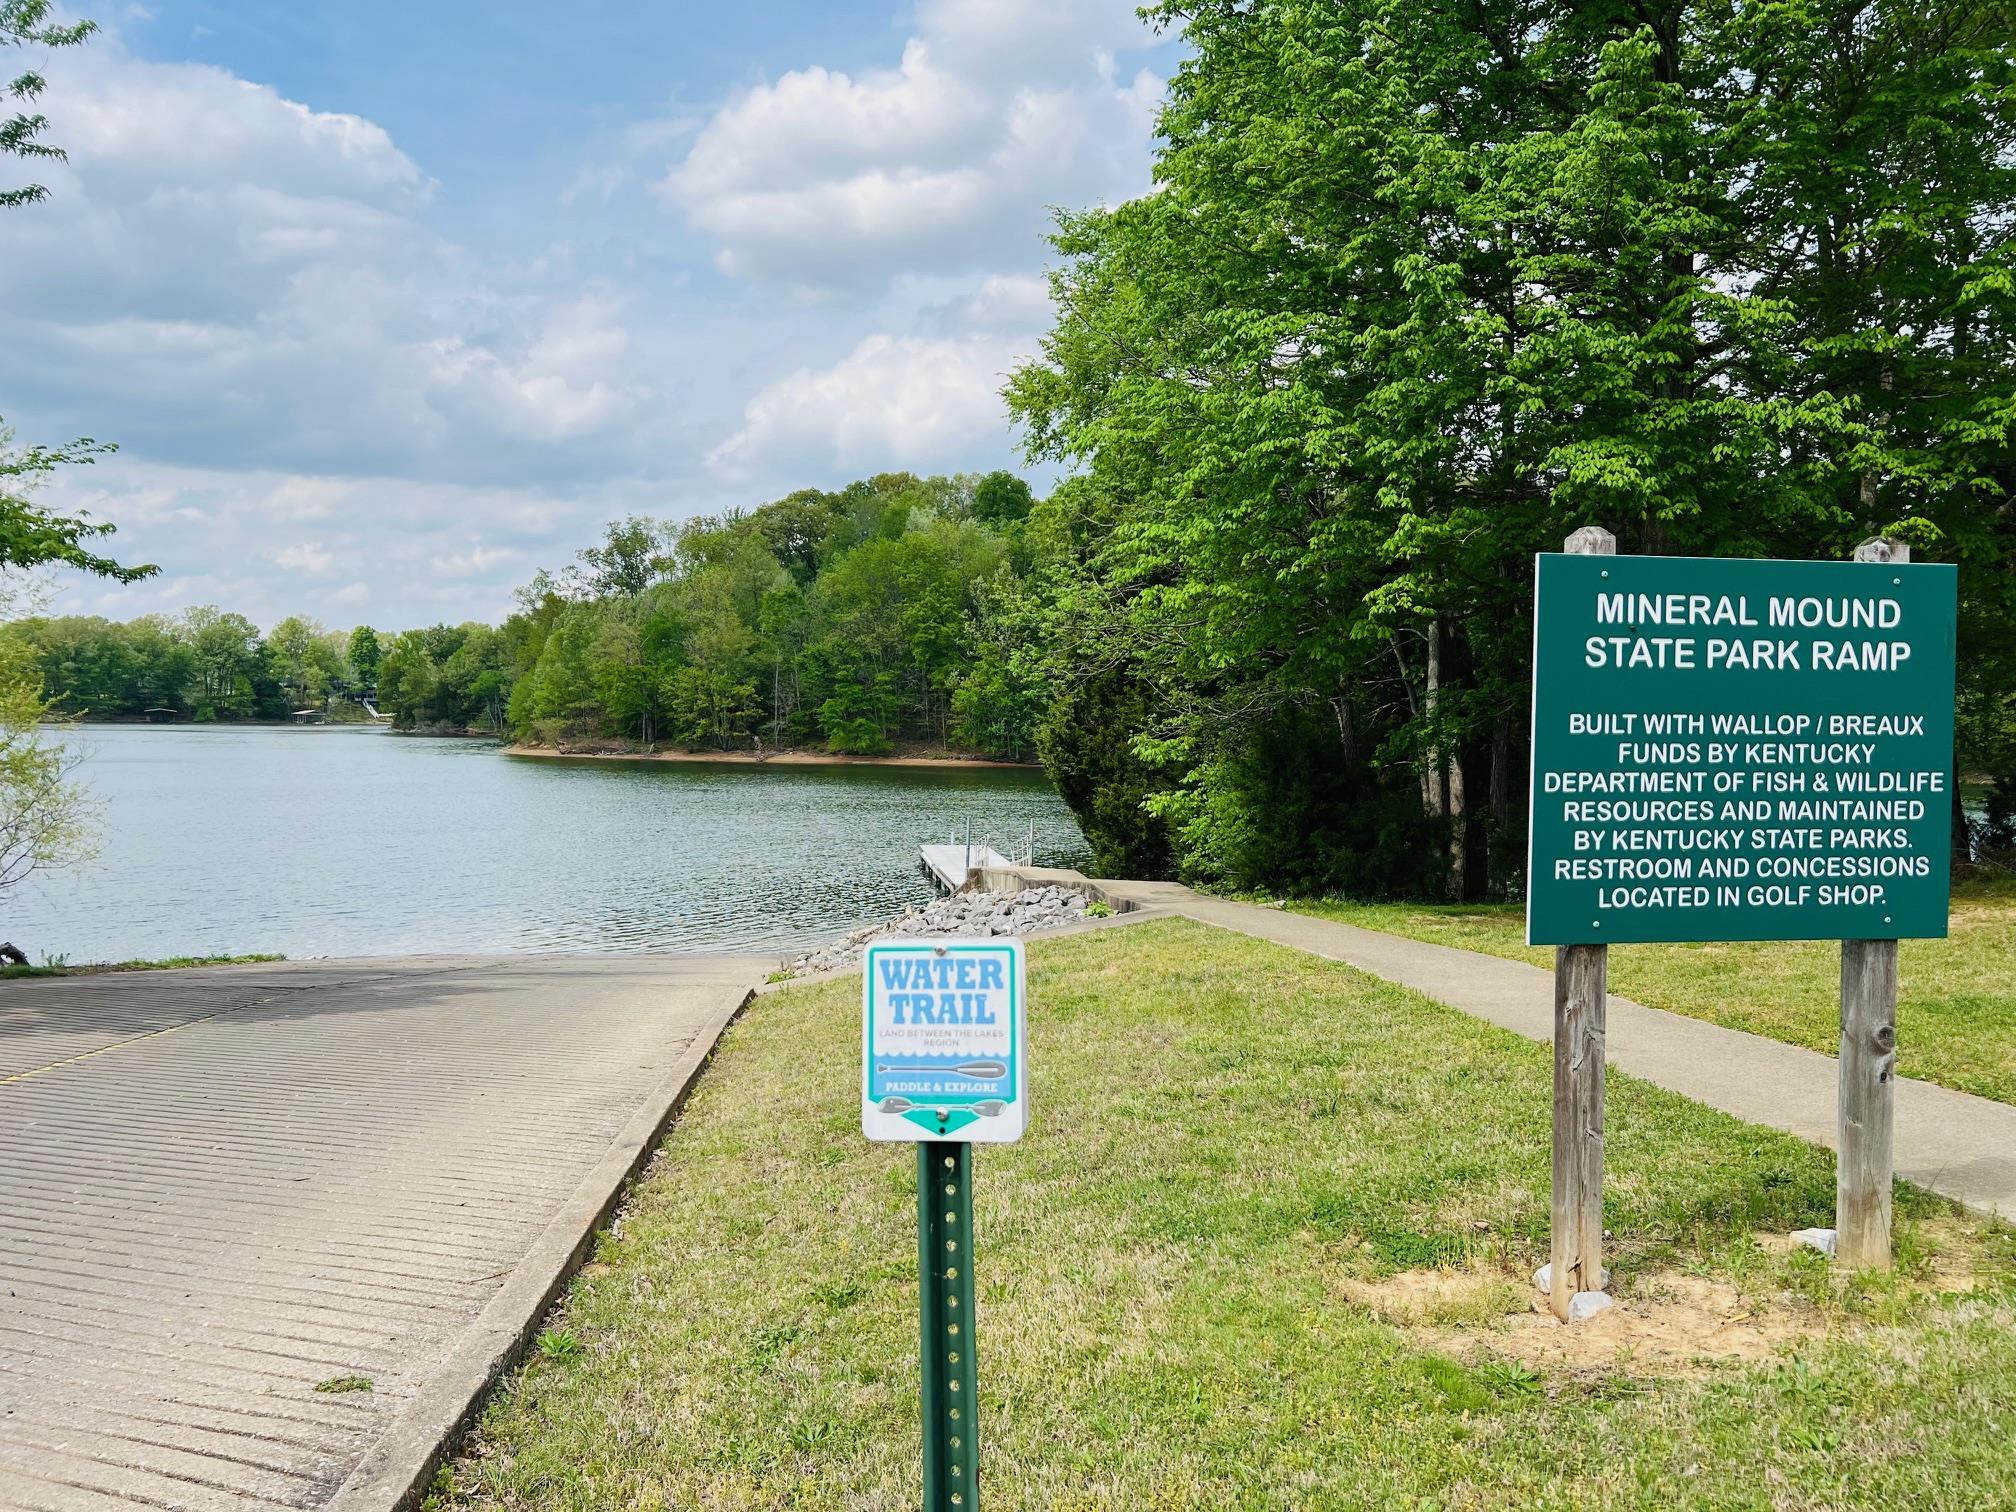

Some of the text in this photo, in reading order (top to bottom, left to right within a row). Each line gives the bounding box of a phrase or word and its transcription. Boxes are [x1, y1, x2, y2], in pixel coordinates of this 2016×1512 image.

[1598, 594, 1900, 628] MINERAL MOUND
[1586, 637, 1910, 671] STATE PARK RAMP
[1570, 714, 1923, 735] BUILT WITH WALLOP / BREAUX
[1619, 743, 1875, 763] FUNDS BY KENTUCKY
[1545, 772, 1943, 792] DEPARTMENT OF FISH & WILDLIFE
[1565, 801, 1924, 821] RESOURCES AND MAINTAINED
[1575, 829, 1912, 850] BY KENTUCKY STATE PARKS.
[1555, 857, 1929, 879] RESTROOM AND CONCESSIONS
[1599, 885, 1885, 908] LOCATED IN GOLF SHOP.
[880, 959, 1004, 989] WATER
[889, 994, 995, 1024] TRAIL
[886, 1082, 998, 1092] PADDLE & EXPLORE
